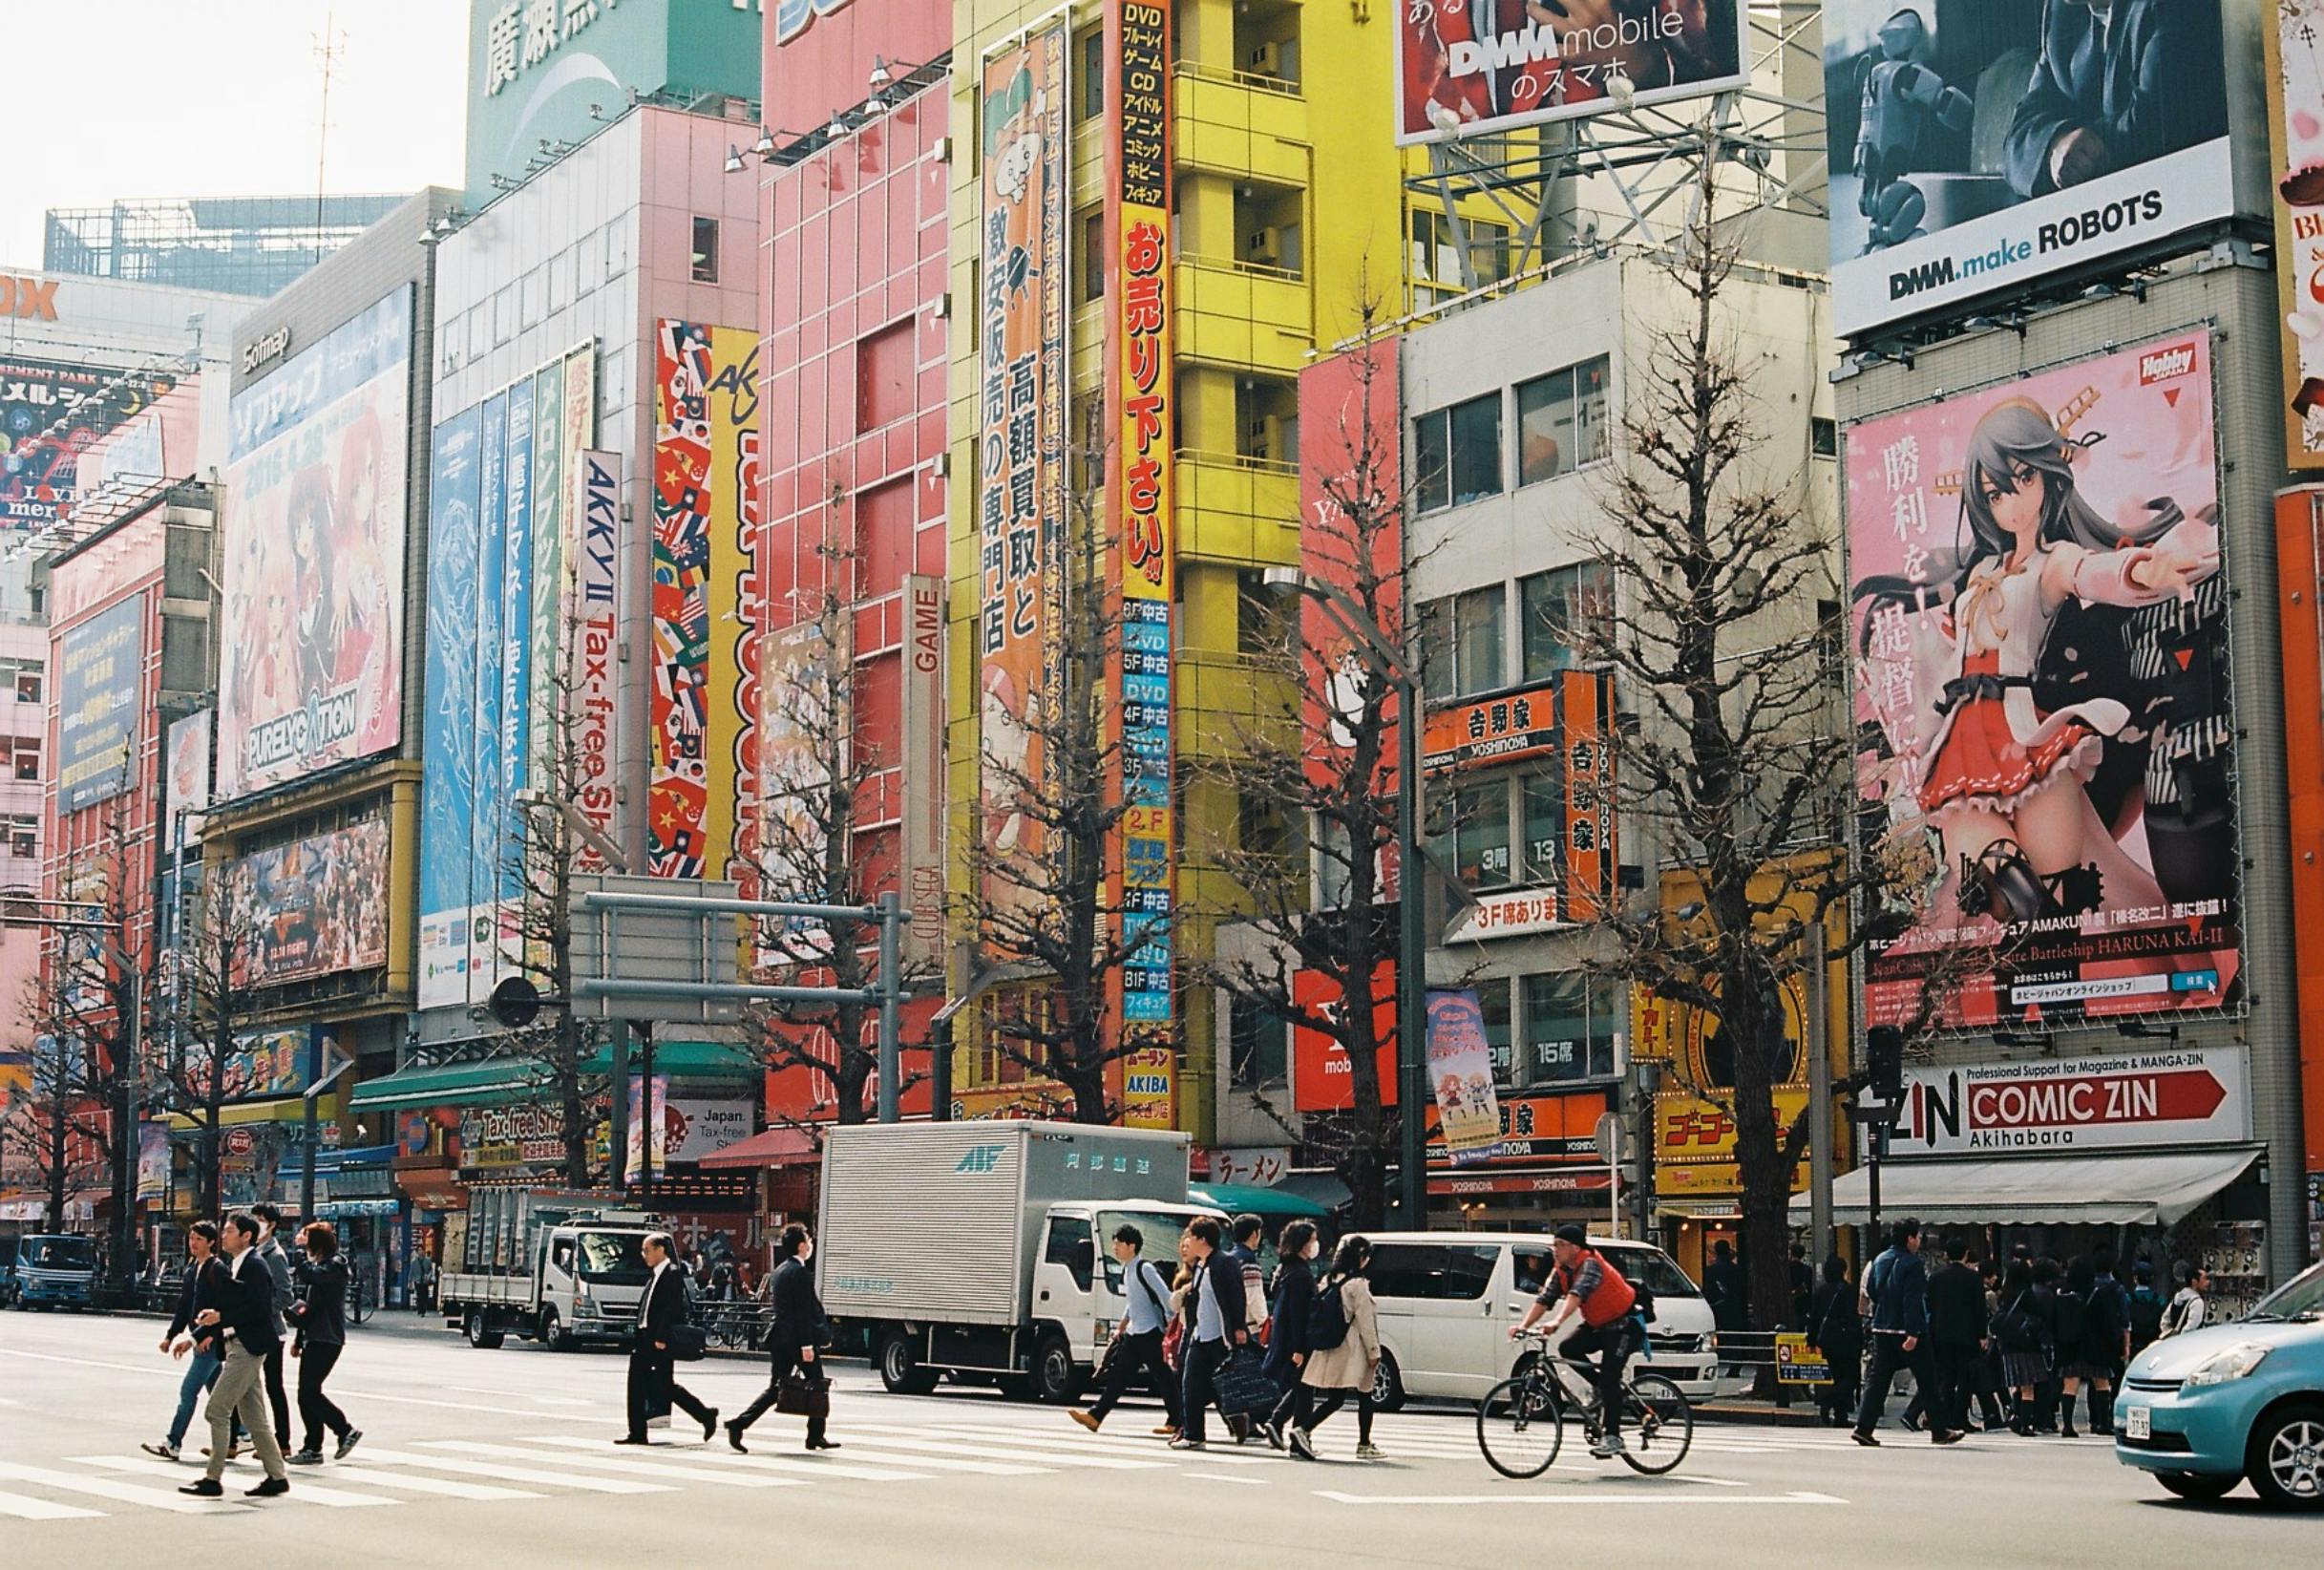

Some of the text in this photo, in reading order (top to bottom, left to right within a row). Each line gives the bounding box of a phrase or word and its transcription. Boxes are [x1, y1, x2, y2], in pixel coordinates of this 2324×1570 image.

[1124, 4, 1161, 27] DVD
[1123, 26, 1164, 50] ブルーレイ
[1449, 7, 1684, 78] DMM mobile
[1124, 49, 1163, 73] ゲーム
[1130, 72, 1155, 92] CD
[1511, 56, 1629, 100] のスマホ
[1124, 94, 1162, 115] アイドル
[1123, 115, 1162, 138] アニメ
[1125, 138, 1161, 160] コミック
[1127, 161, 1160, 181] ホビー
[1125, 183, 1161, 206] フィギュア
[1890, 190, 2164, 301] DMM.make ROBOTS
[243, 326, 291, 375] Sofmap
[2142, 348, 2194, 379] Hobby
[982, 203, 1009, 659] 激安販売の専門店
[1008, 350, 1038, 639] 高額買取と
[584, 457, 616, 586] AKKY
[1142, 603, 1169, 623] 中古
[915, 589, 939, 672] GAME
[1124, 652, 1169, 674] 5F 中古
[583, 613, 616, 777] Tax-free
[1127, 683, 1166, 701] DVD
[1124, 704, 1169, 726] 4F 中古
[1470, 734, 1529, 757] YOSHINOYA
[1124, 759, 1140, 774] 3F
[1424, 754, 1454, 768] OSHINOYA
[1482, 839, 1555, 870] 3階 13
[913, 864, 939, 902] SEGA
[1143, 892, 1170, 911] 中古
[2030, 941, 2095, 963] Battleship
[2099, 933, 2172, 954] HARUNA
[1125, 970, 1170, 989] B1F 中古
[2017, 982, 2133, 1000] ホビージャパンオンラインショップ
[1537, 1040, 1574, 1065] 15席
[1325, 1059, 1352, 1074] mob
[1967, 1052, 2204, 1080] Professional Support for Magazine & MANGA-ZIN
[1127, 1076, 1168, 1094] AKIBA
[1972, 1082, 2095, 1125] COMIC
[2104, 1078, 2158, 1119] ZIN
[537, 1108, 567, 1136] Sho
[704, 1109, 747, 1124] Japan.
[699, 1125, 747, 1138] Tax-free
[1971, 1128, 2074, 1148] Akihabara
[1566, 1140, 1596, 1152] YOSHINO
[1218, 1156, 1282, 1184] ラーメン
[1450, 1178, 1577, 1193] YOSHINOYA YOSHINOYA
